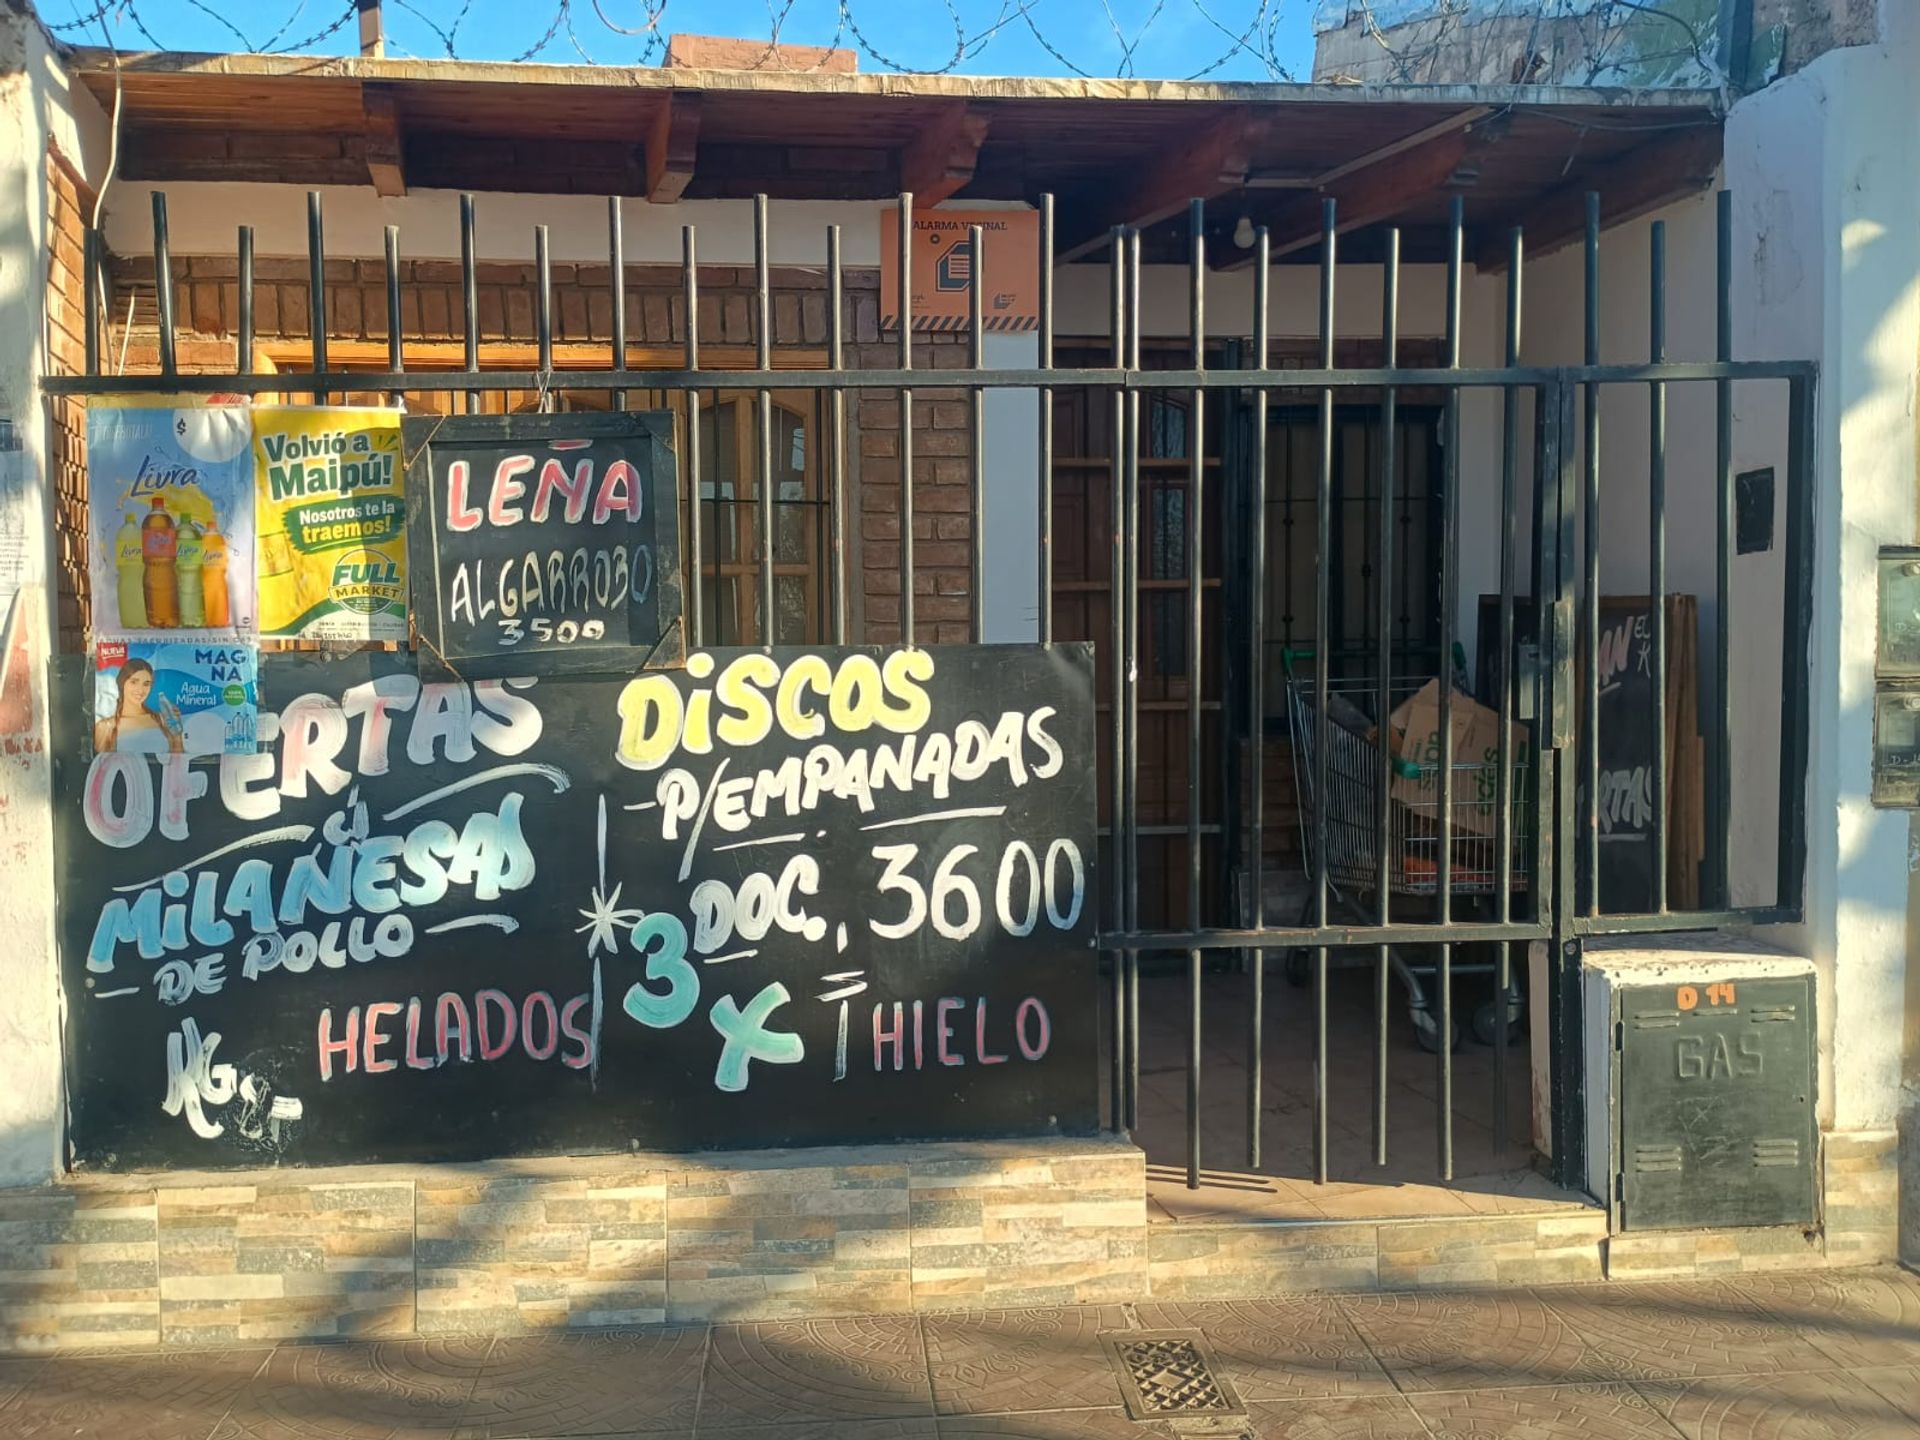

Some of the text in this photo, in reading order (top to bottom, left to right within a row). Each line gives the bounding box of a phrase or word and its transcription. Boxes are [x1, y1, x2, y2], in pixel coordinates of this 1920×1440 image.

[912, 220, 959, 230] ALARMA
[176, 418, 187, 435] $
[263, 433, 369, 462] Volvió a
[131, 455, 199, 497] Livra
[269, 453, 393, 501] Maipú!
[447, 438, 643, 532] LEÑA
[300, 500, 395, 525] Nosotros te la
[302, 516, 391, 544] traemos!
[332, 563, 401, 586] FULL
[450, 545, 652, 627] ALGARROBO
[335, 586, 400, 599] MARKET
[498, 618, 605, 645] 3500
[195, 649, 246, 664] MAG
[181, 681, 210, 695] Agua
[211, 667, 242, 681] NA
[176, 692, 217, 706] Mineral
[83, 673, 543, 848] OFERTAS
[869, 838, 1085, 940] 3600
[153, 914, 414, 1004] DE POLLO
[623, 912, 700, 1028] 3
[318, 990, 594, 1082] HELADOS
[873, 997, 1050, 1072] HIELO
[1677, 1032, 1763, 1080] GAS
